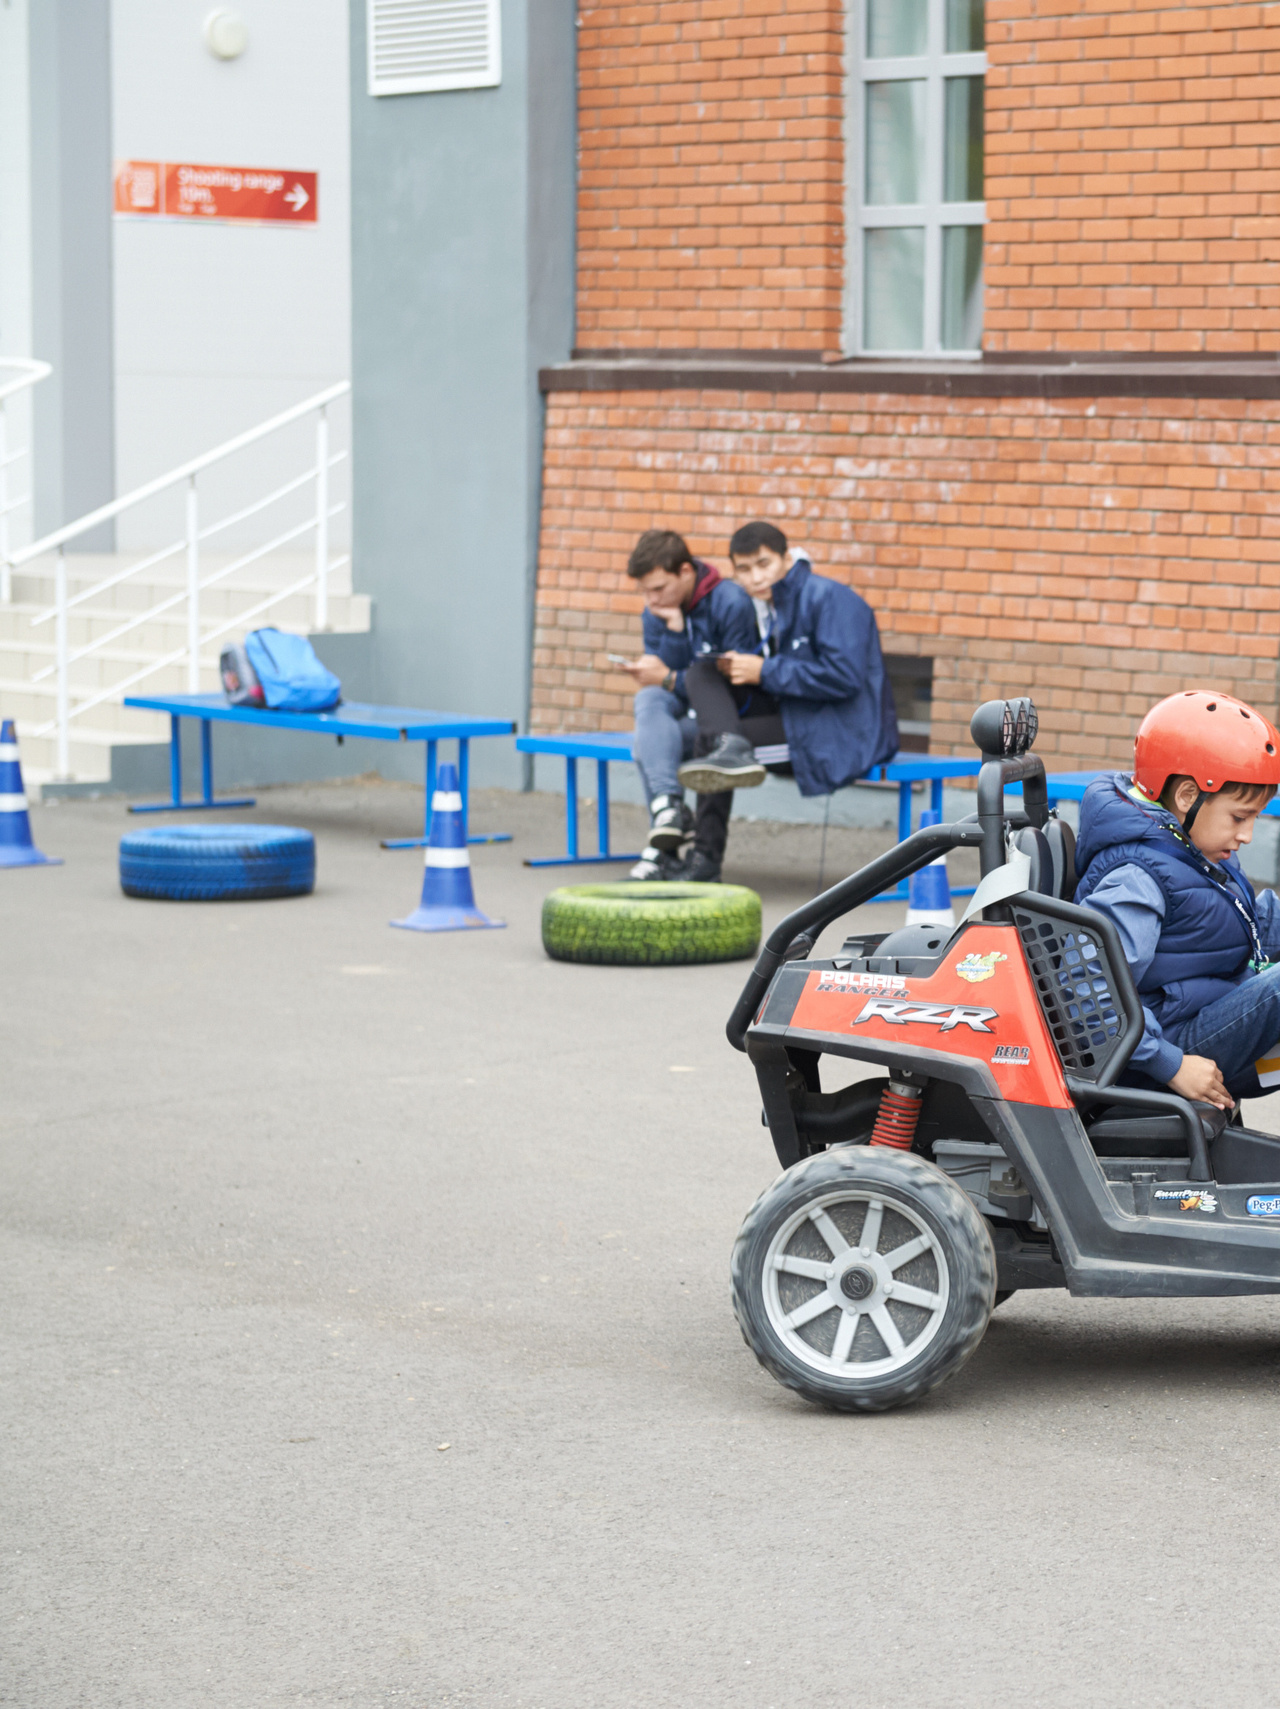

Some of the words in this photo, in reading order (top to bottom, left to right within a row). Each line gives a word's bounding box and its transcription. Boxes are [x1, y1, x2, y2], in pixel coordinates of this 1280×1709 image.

[177, 166, 242, 191] Shooting
[243, 173, 285, 194] range
[820, 970, 907, 990] POLARIS
[815, 983, 910, 998] RANGER
[852, 997, 999, 1034] RZR
[994, 1045, 1030, 1058] REAR
